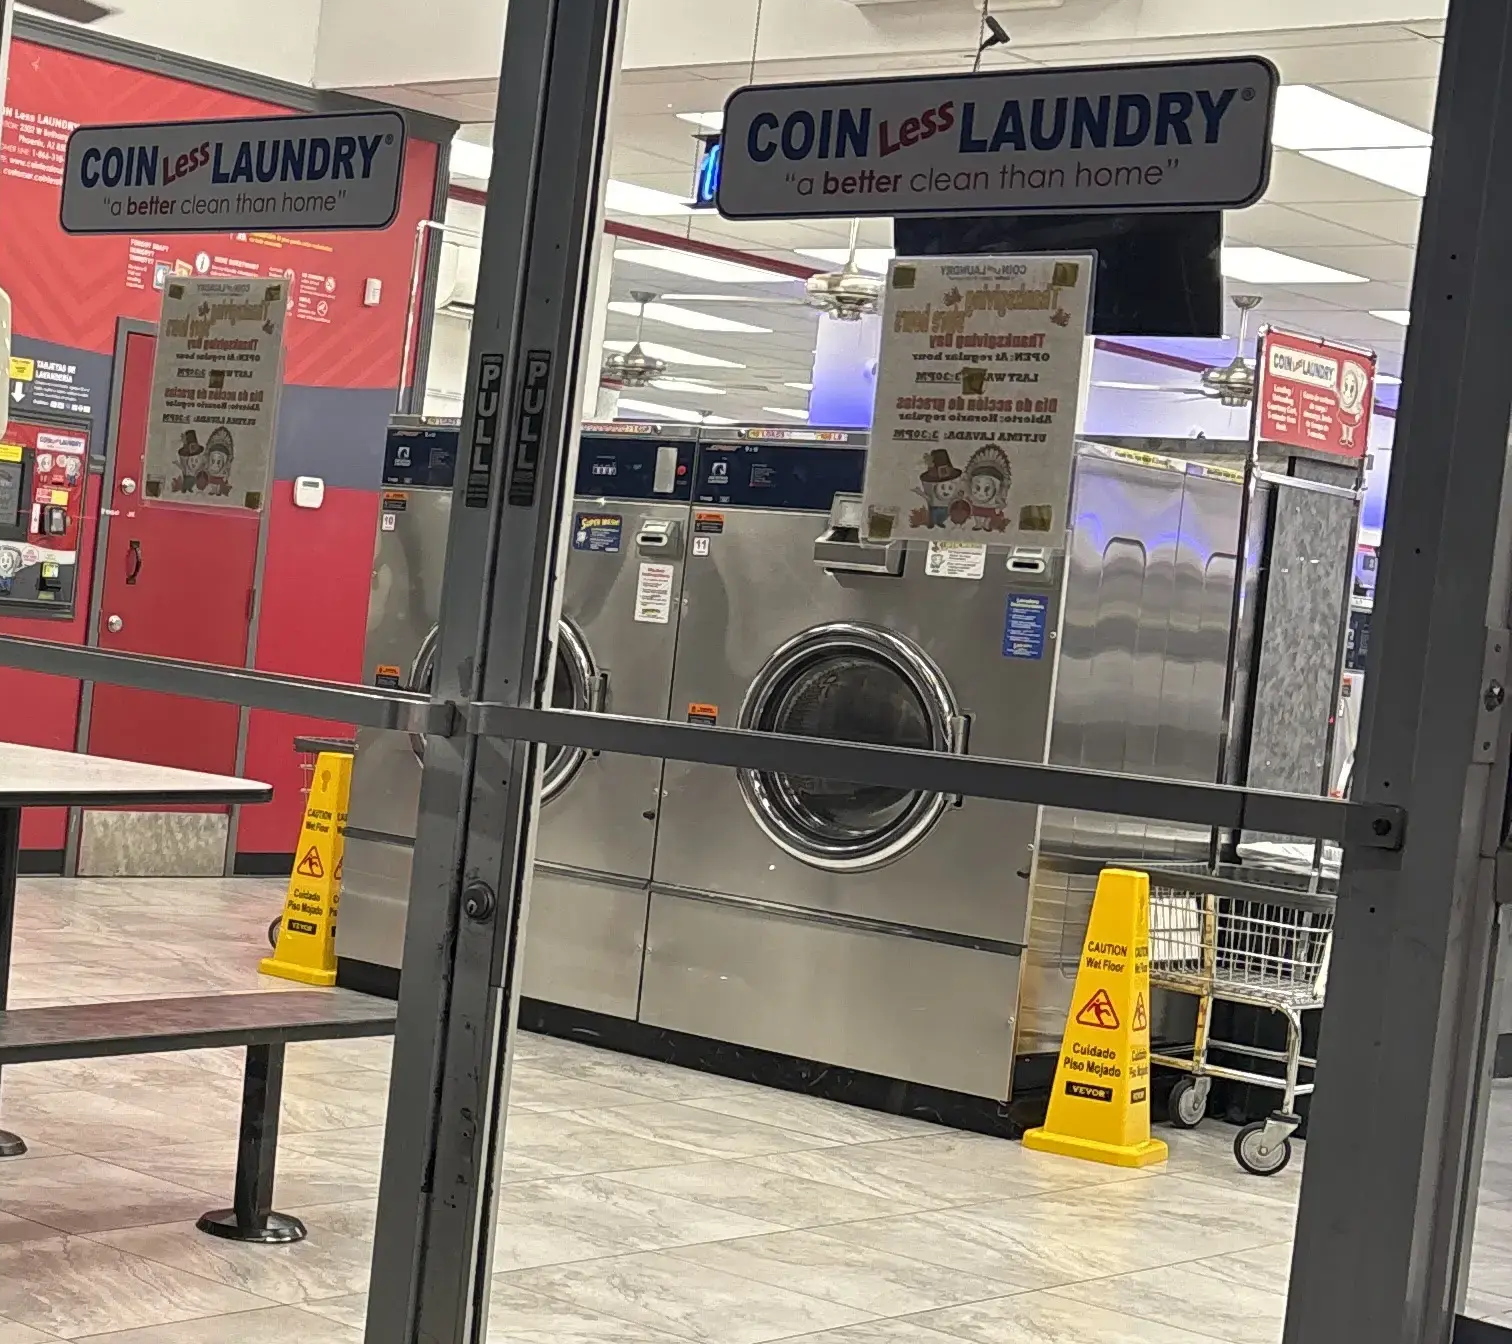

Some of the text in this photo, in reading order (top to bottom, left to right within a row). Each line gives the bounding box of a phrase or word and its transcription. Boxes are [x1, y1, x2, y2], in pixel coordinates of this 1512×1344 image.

[746, 106, 873, 163] COIN
[878, 101, 956, 159] Less
[80, 144, 160, 189] COIN
[162, 141, 211, 186] Less
[822, 168, 903, 196] better
[908, 165, 990, 193] clean
[997, 162, 1066, 189] than
[125, 196, 178, 217] better
[180, 194, 231, 215] clean
[235, 191, 277, 215] than
[472, 364, 501, 472] PULL
[517, 360, 548, 470] PULL
[1087, 940, 1128, 958] CAUTION
[1085, 956, 1125, 973] Wet Floor
[1072, 1042, 1117, 1060] Cuidado
[1063, 1056, 1085, 1072] Piso
[1086, 1060, 1121, 1078] Mojado
[1071, 1085, 1108, 1099] VEVOR
